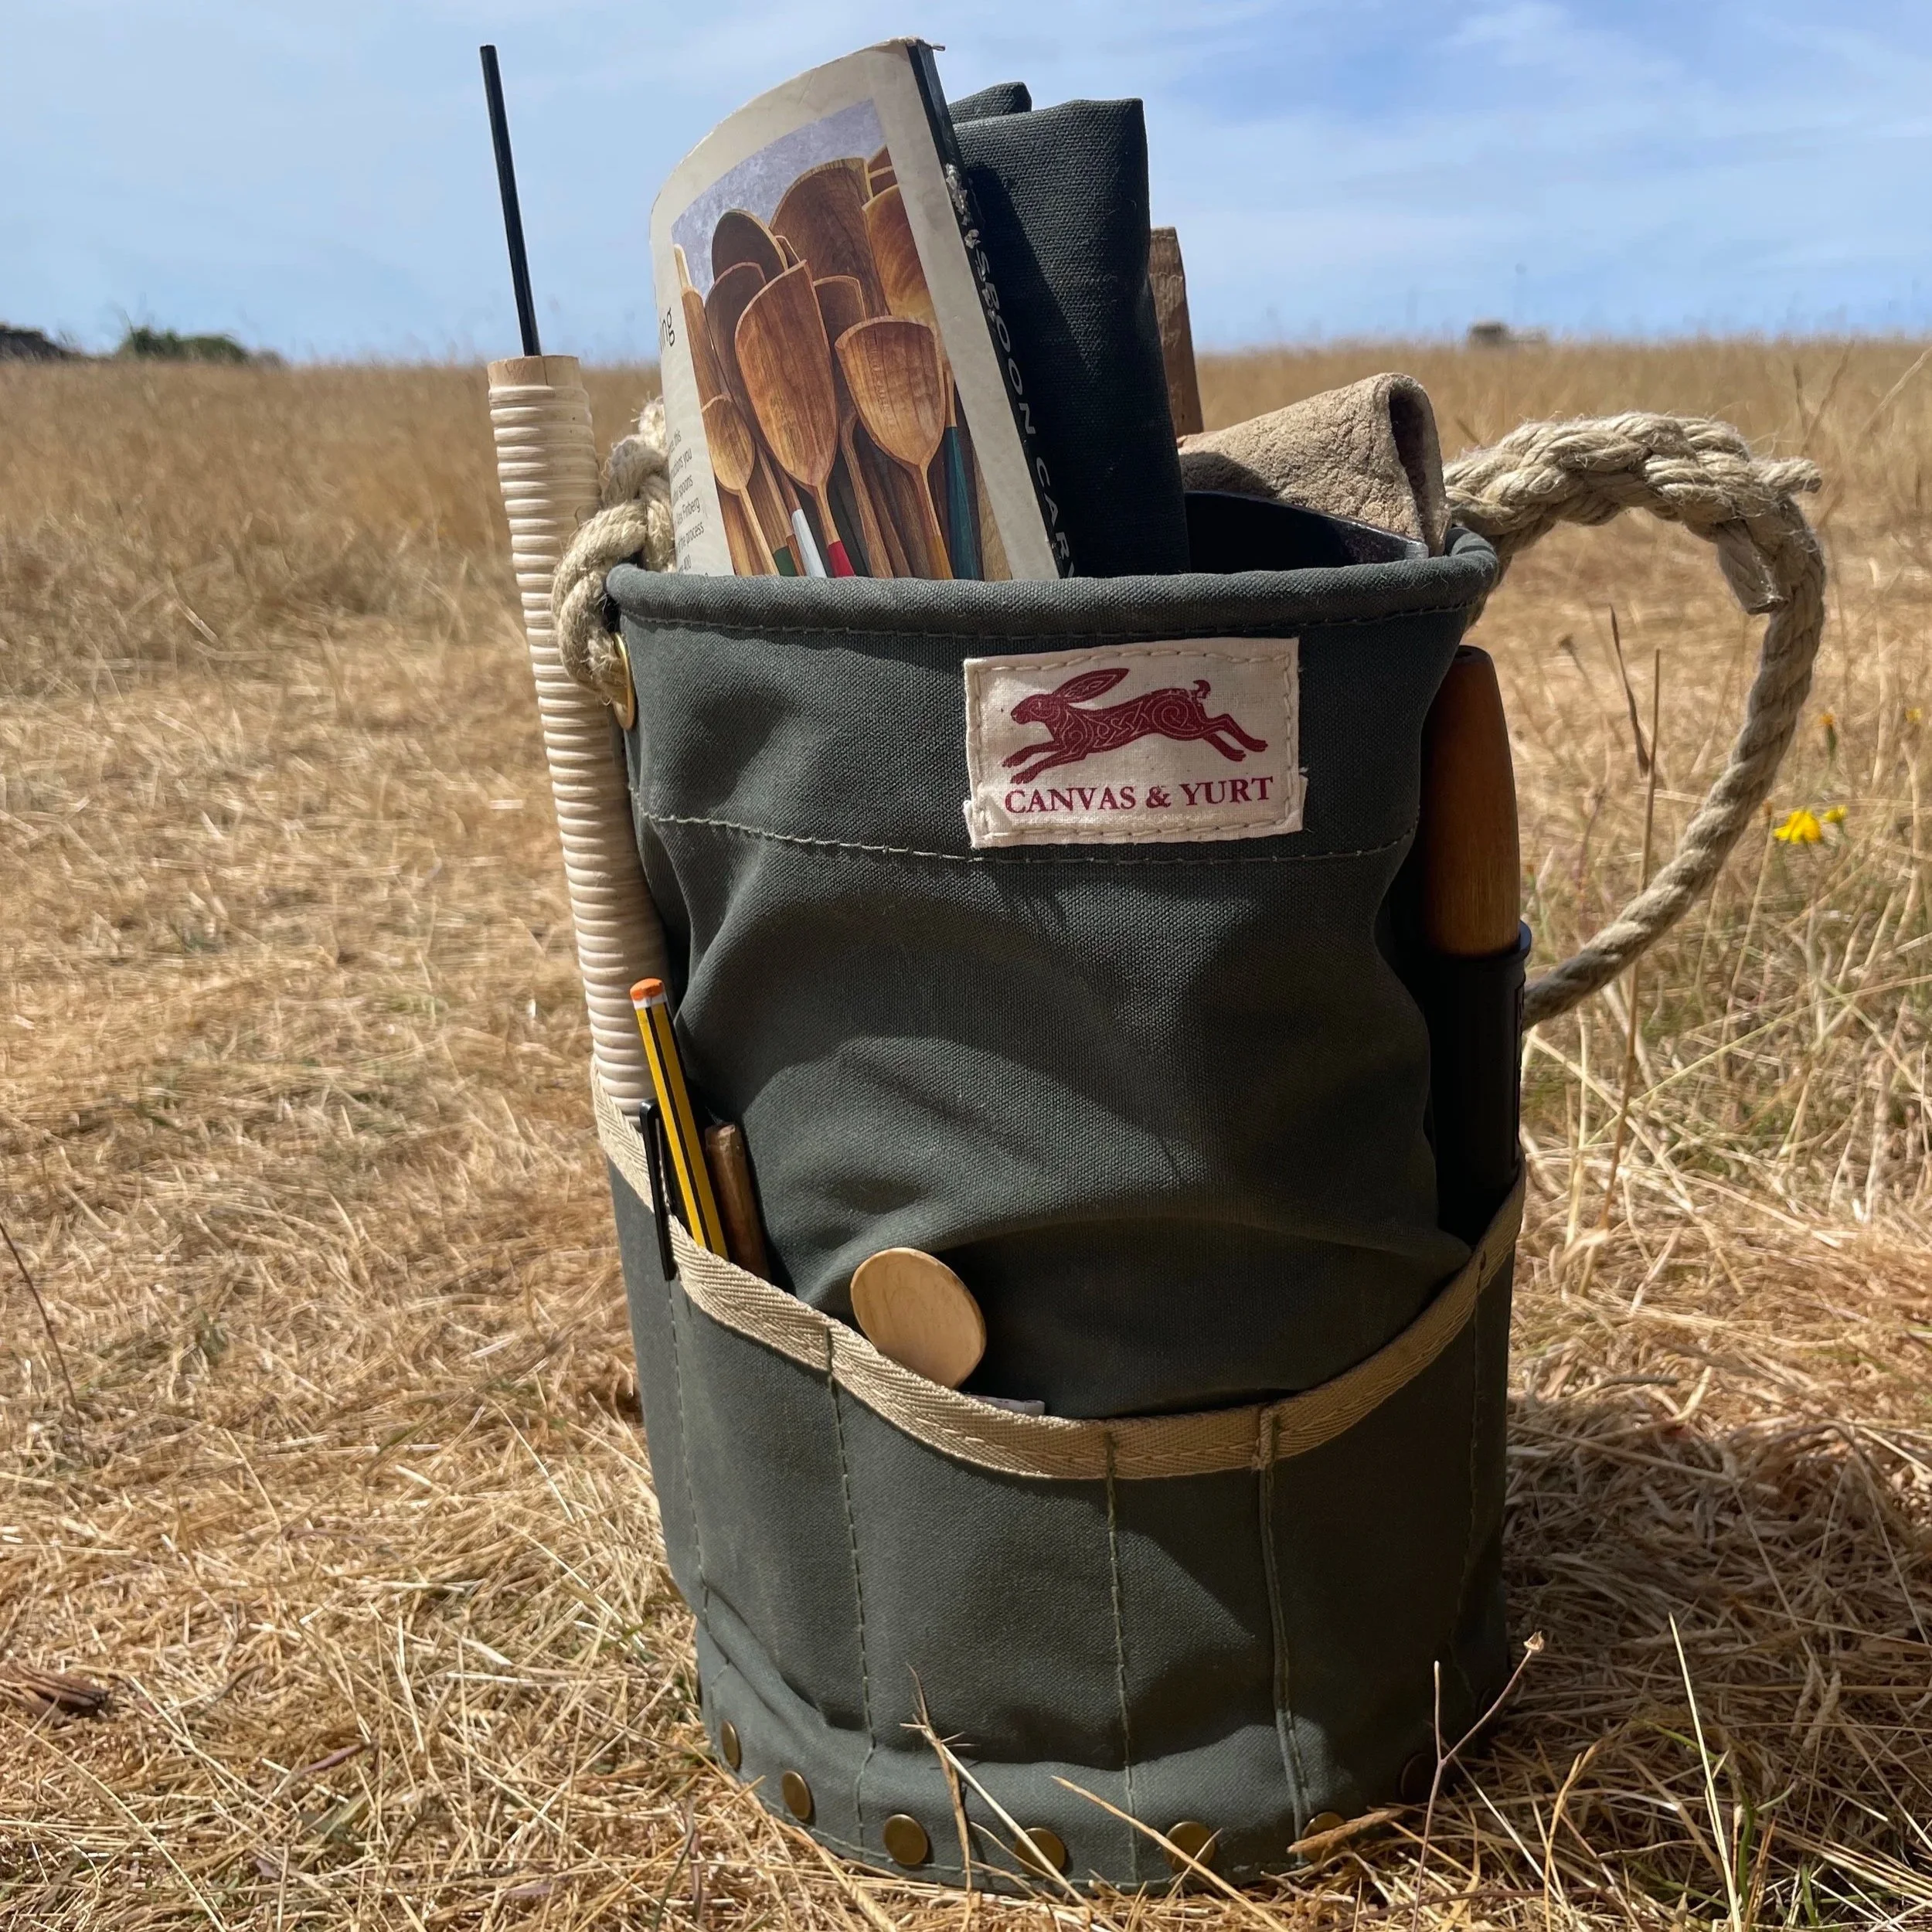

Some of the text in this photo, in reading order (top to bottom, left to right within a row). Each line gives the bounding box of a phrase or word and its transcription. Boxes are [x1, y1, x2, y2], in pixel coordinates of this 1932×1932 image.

[1005, 776, 1274, 814] CANVAS & YURT
